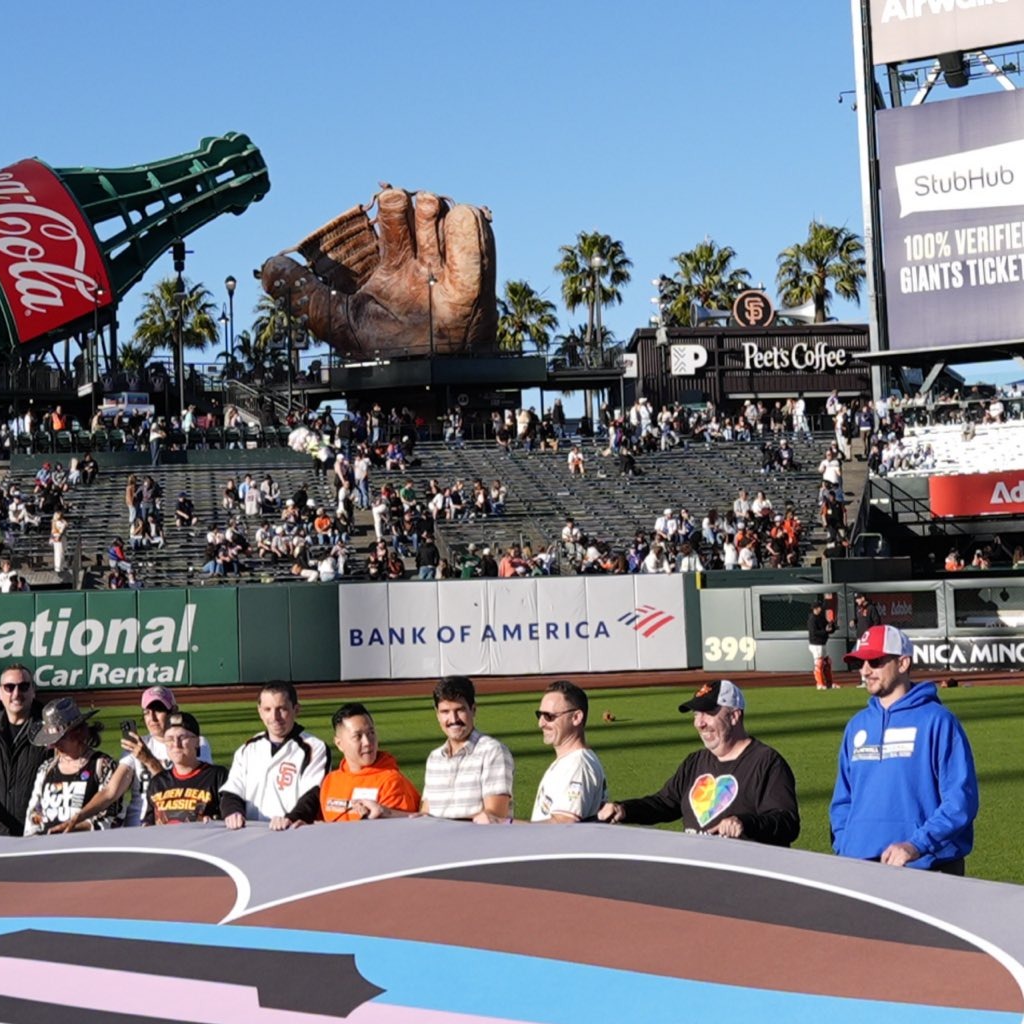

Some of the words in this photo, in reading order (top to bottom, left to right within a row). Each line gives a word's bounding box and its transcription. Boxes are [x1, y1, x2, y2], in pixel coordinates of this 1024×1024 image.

[914, 165, 1015, 197] StubHub
[904, 231, 952, 262] 100%
[955, 221, 1024, 256] VERIFIE
[900, 261, 964, 294] GIANTS
[742, 342, 790, 370] Peet's
[791, 342, 847, 372] Coffee
[349, 626, 427, 648] BANK
[437, 625, 472, 645] OF
[481, 620, 611, 643] AMERICA
[704, 636, 757, 662] 399
[913, 643, 964, 664] NICA
[34, 664, 84, 687] Car
[87, 659, 186, 686] Rental
[151, 787, 184, 802] OLDEN
